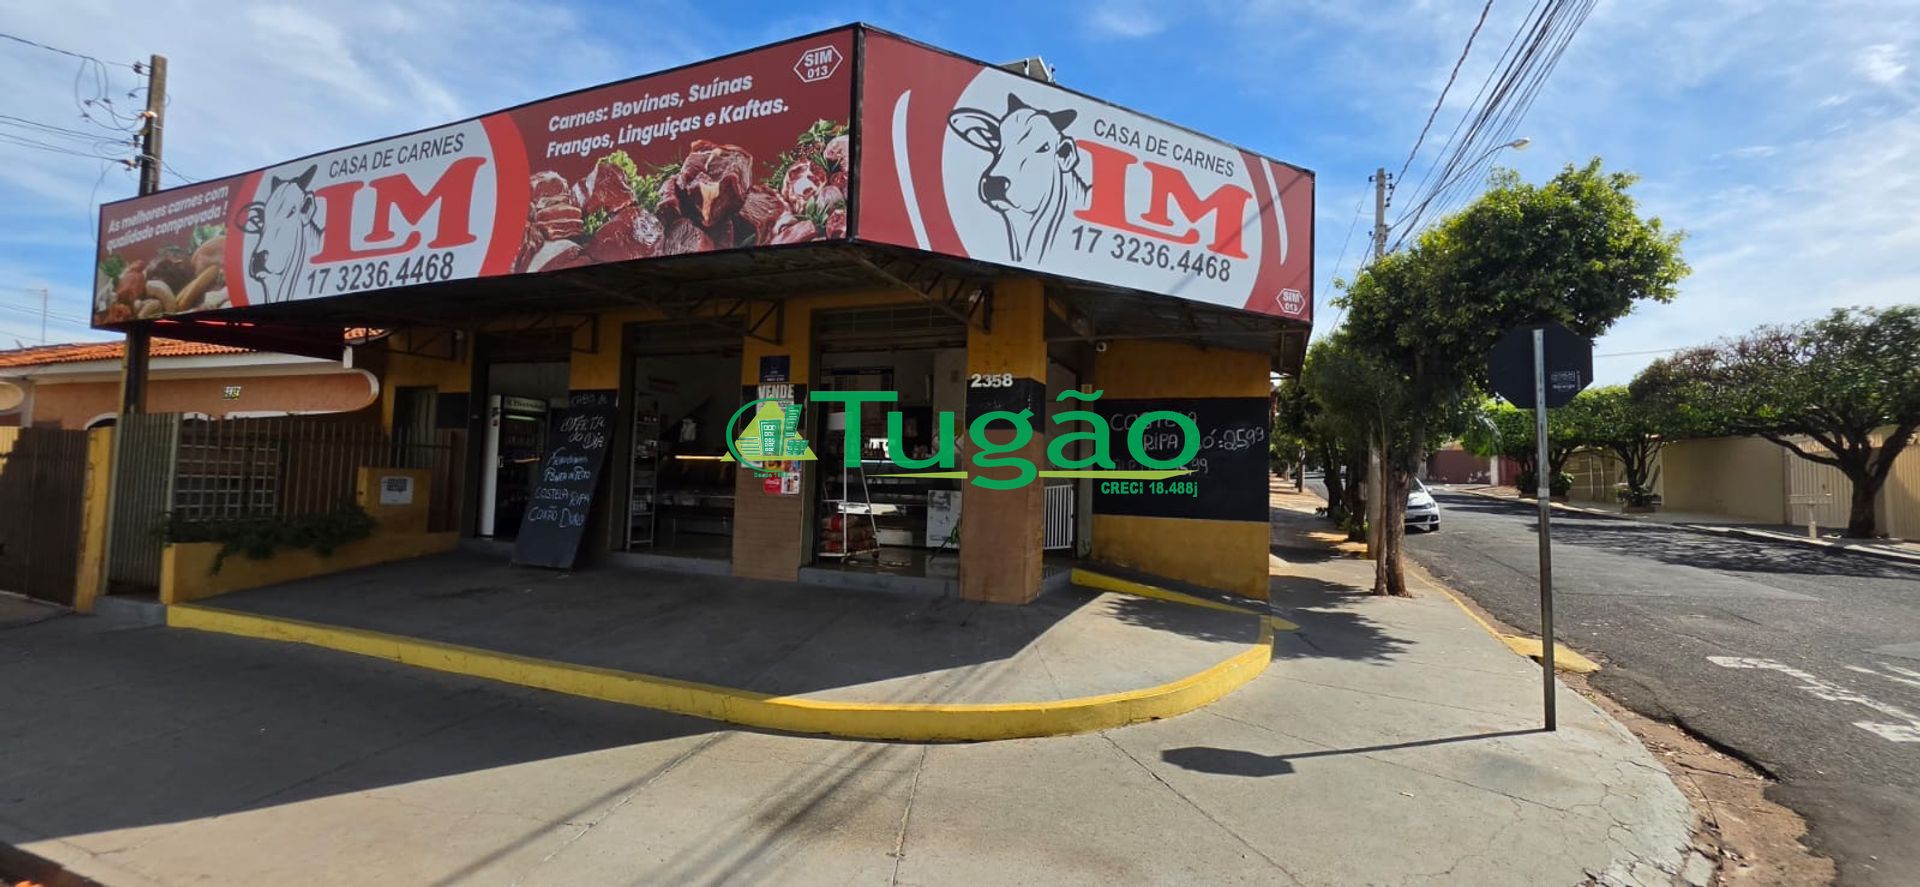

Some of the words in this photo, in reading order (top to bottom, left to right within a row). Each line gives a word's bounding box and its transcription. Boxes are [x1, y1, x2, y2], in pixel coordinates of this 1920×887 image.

[804, 49, 832, 68] SIM
[806, 64, 829, 79] 013
[548, 106, 609, 132] Carnes:
[611, 92, 685, 120] Bovinas,
[687, 73, 753, 103] Suínas
[546, 131, 615, 159] Frangos,
[617, 114, 701, 146] Linguiças
[703, 111, 717, 129] e
[718, 96, 790, 125] Kaftas.
[1093, 118, 1142, 150] CASA
[1145, 135, 1169, 158] DE
[1172, 144, 1235, 178] CARNES
[328, 156, 369, 179] CASA
[371, 148, 396, 171] DE
[397, 131, 466, 166] CARNES
[108, 219, 122, 234] As
[121, 203, 167, 229] melhores
[167, 193, 204, 215] carnes
[204, 185, 229, 204] com
[308, 155, 488, 265] LM
[1072, 138, 1254, 260] LM
[107, 226, 154, 256] qualidade
[154, 204, 222, 238] comprovada
[1071, 225, 1103, 254] 17
[1110, 234, 1232, 283] 3236.4468
[306, 267, 330, 296] 17
[335, 251, 455, 293] 3236.4468
[1282, 290, 1300, 304] SIM
[757, 384, 795, 399] VENDE
[970, 373, 1013, 388] 2358
